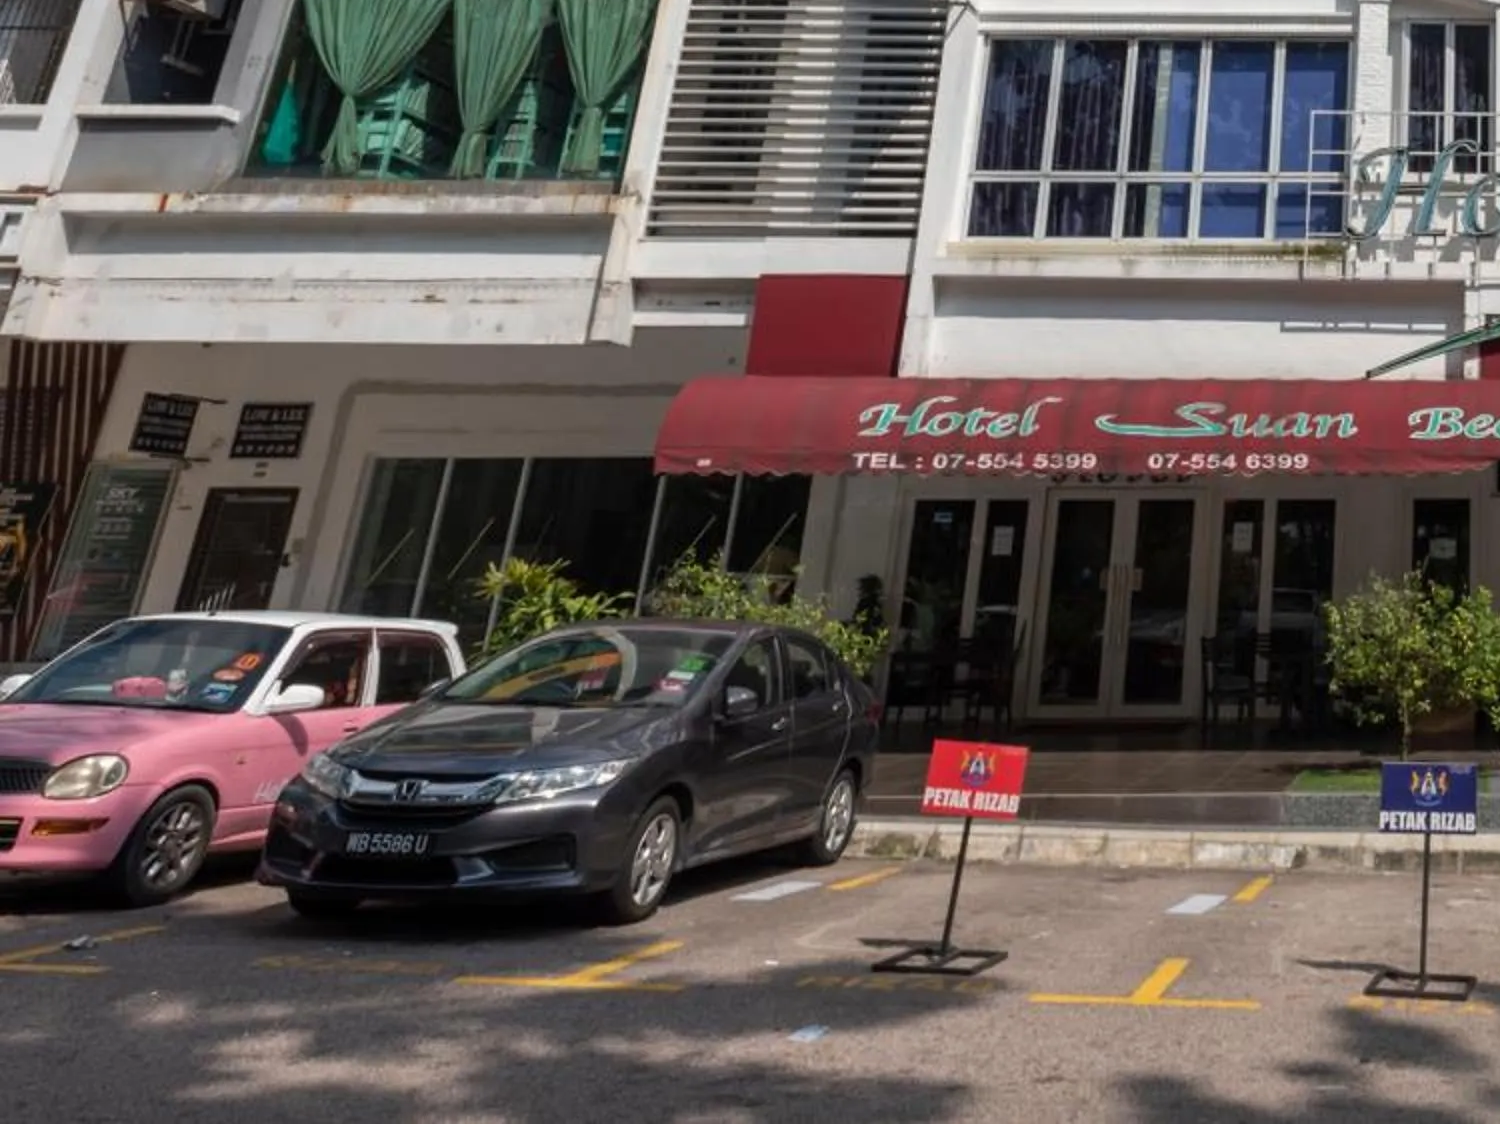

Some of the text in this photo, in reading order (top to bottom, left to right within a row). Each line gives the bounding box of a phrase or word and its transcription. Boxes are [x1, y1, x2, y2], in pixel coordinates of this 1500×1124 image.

[858, 395, 1064, 438] Hotel
[1095, 401, 1359, 439] Suan
[853, 453, 906, 469] TEL
[932, 453, 1024, 469] 07-554
[1032, 453, 1097, 469] 5399
[1147, 453, 1237, 469] 07-554
[1245, 453, 1309, 469] 6399
[922, 786, 1021, 813] PETAK RIZAB
[1380, 810, 1477, 832] PETAK RIZAB
